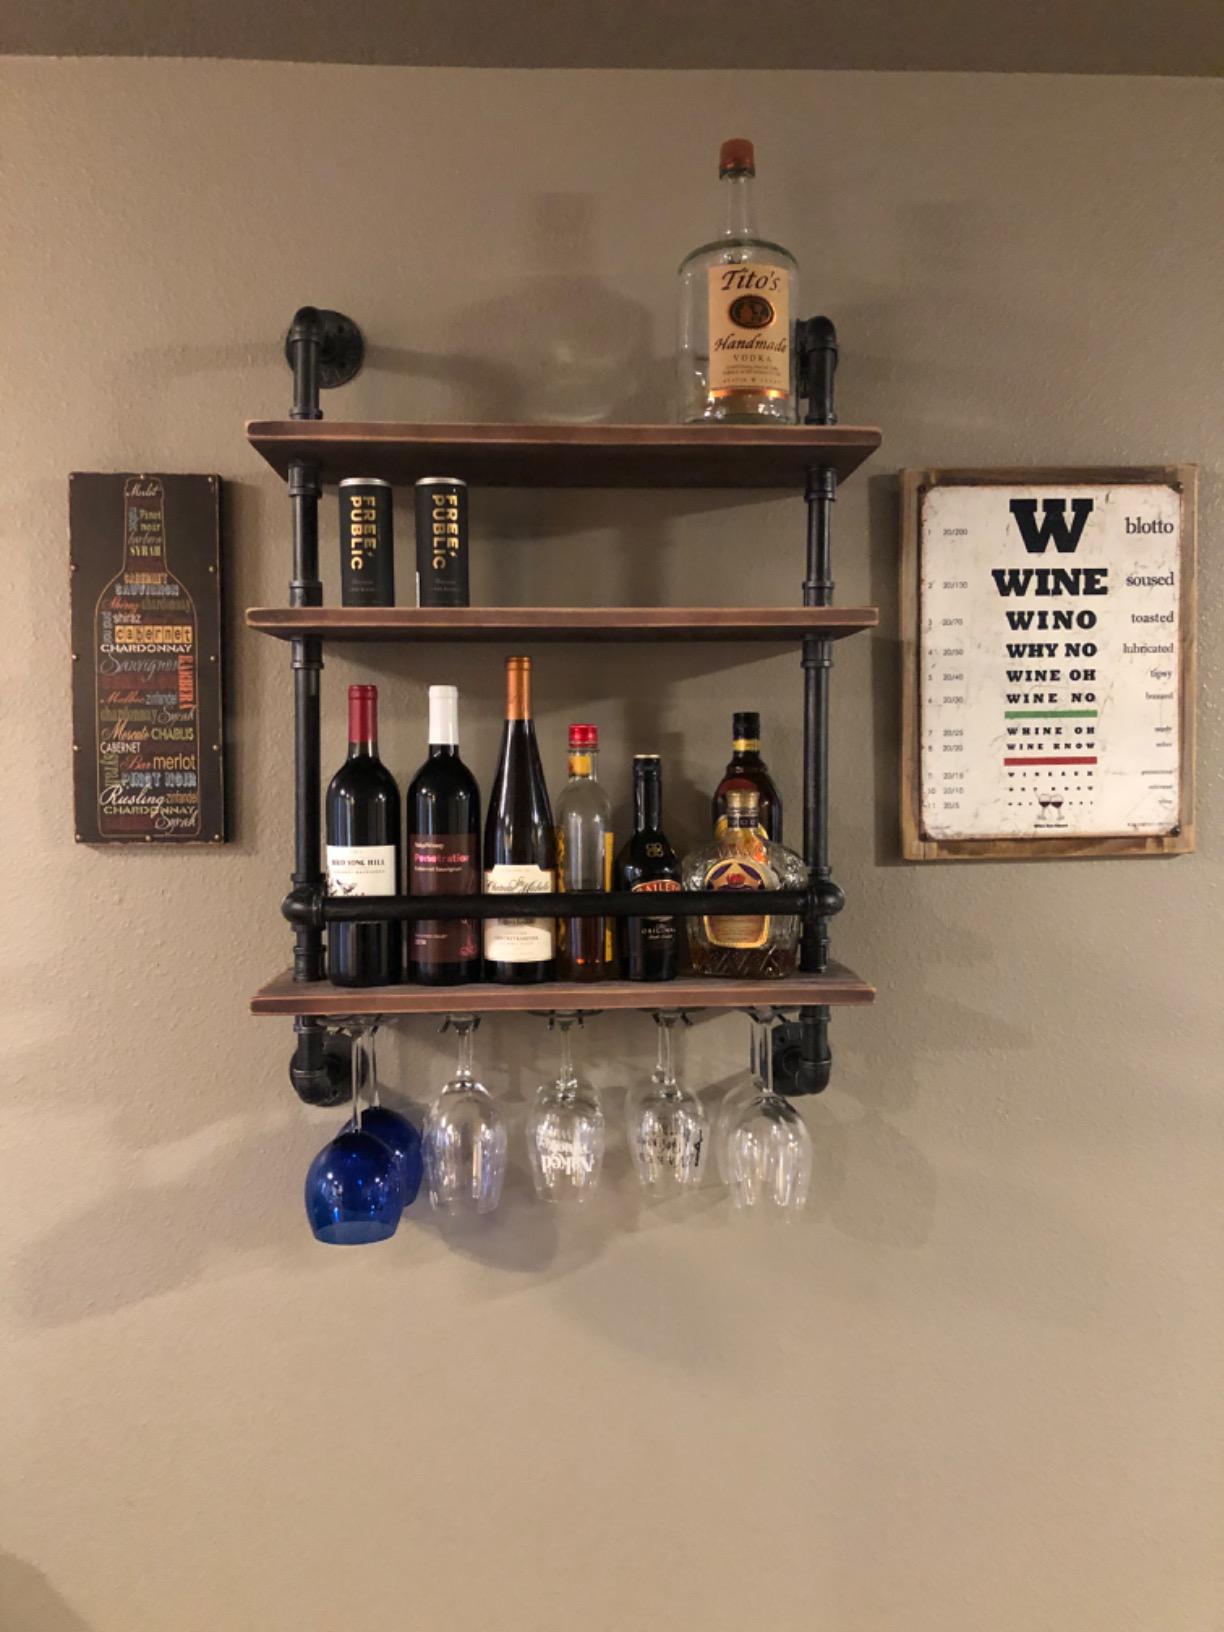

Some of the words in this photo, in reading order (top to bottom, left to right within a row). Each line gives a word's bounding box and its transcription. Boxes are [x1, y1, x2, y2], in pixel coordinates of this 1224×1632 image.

[721, 267, 781, 291] Tito's
[714, 333, 788, 353] Handmade
[733, 353, 772, 362] VODKA
[432, 494, 447, 570] PUBLIC
[1009, 498, 1094, 553] W
[1125, 516, 1175, 535] blotto
[350, 496, 364, 571] PUBLIC
[991, 568, 1108, 597] WINE
[1125, 571, 1175, 587] soused
[1005, 610, 1097, 631] WINO
[1130, 610, 1175, 624] toasted
[115, 626, 193, 644] cabernet
[100, 644, 193, 653] CHARDONNAY
[1006, 644, 1058, 658] WHY
[1064, 643, 1097, 657] NO
[1123, 643, 1175, 655] lubricated
[1006, 670, 1062, 683] WINE
[1069, 669, 1097, 682] OH
[1006, 693, 1058, 705] WINE
[1070, 692, 1097, 704] NO
[151, 727, 194, 741] CHABLIS
[1007, 727, 1063, 735] WHINE
[1074, 726, 1096, 735] OH
[100, 741, 141, 754] CABERNET
[1053, 742, 1096, 750] KNOW
[153, 752, 197, 770] merlot
[103, 805, 195, 815] CHARDONNAY
[414, 854, 470, 863] Penetration
